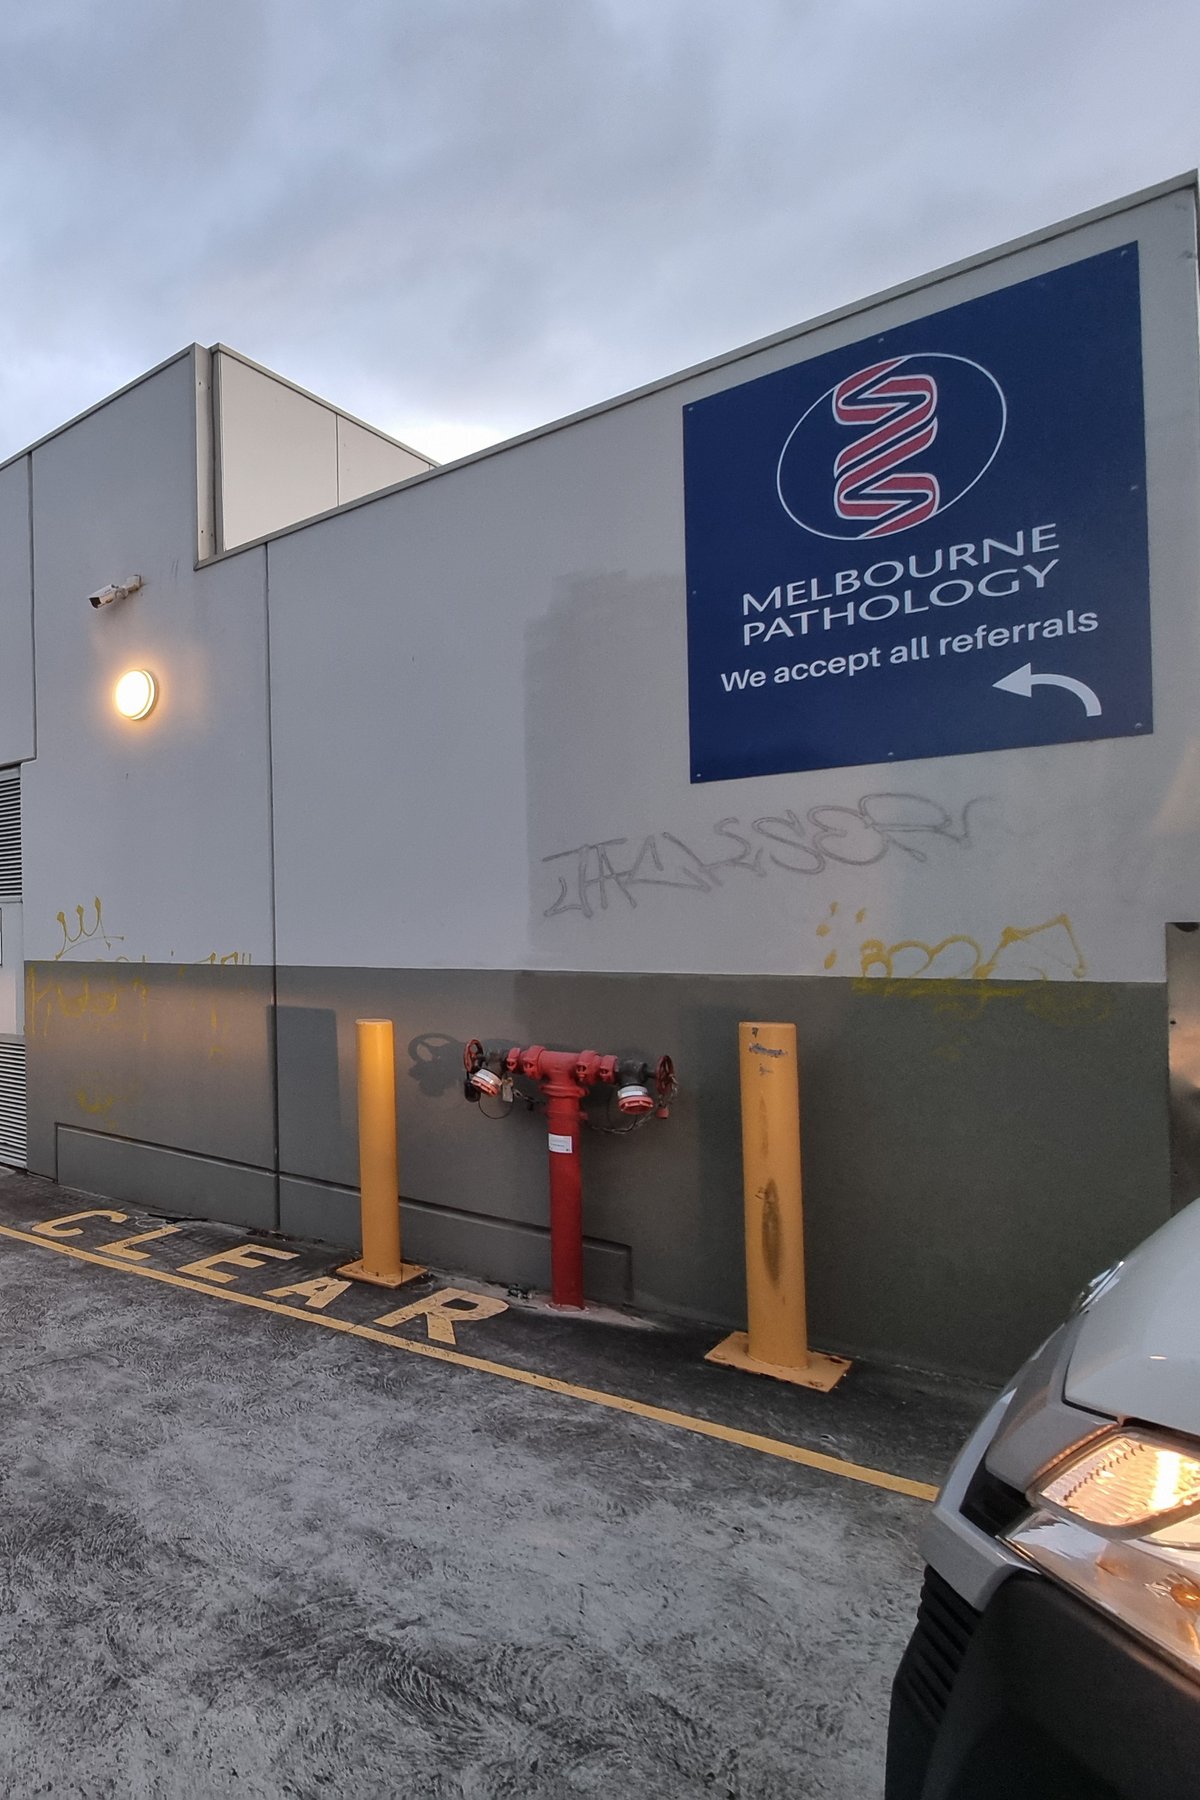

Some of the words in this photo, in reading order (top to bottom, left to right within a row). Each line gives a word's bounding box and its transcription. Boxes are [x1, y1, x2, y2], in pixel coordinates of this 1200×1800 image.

[742, 522, 1061, 616] MELBOURNE
[743, 558, 1060, 646] PATHOLOGY
[721, 668, 767, 693] We
[773, 647, 881, 684] accept
[889, 636, 930, 665] all
[938, 609, 1100, 656] referrals
[31, 1209, 510, 1346] CLEAR
